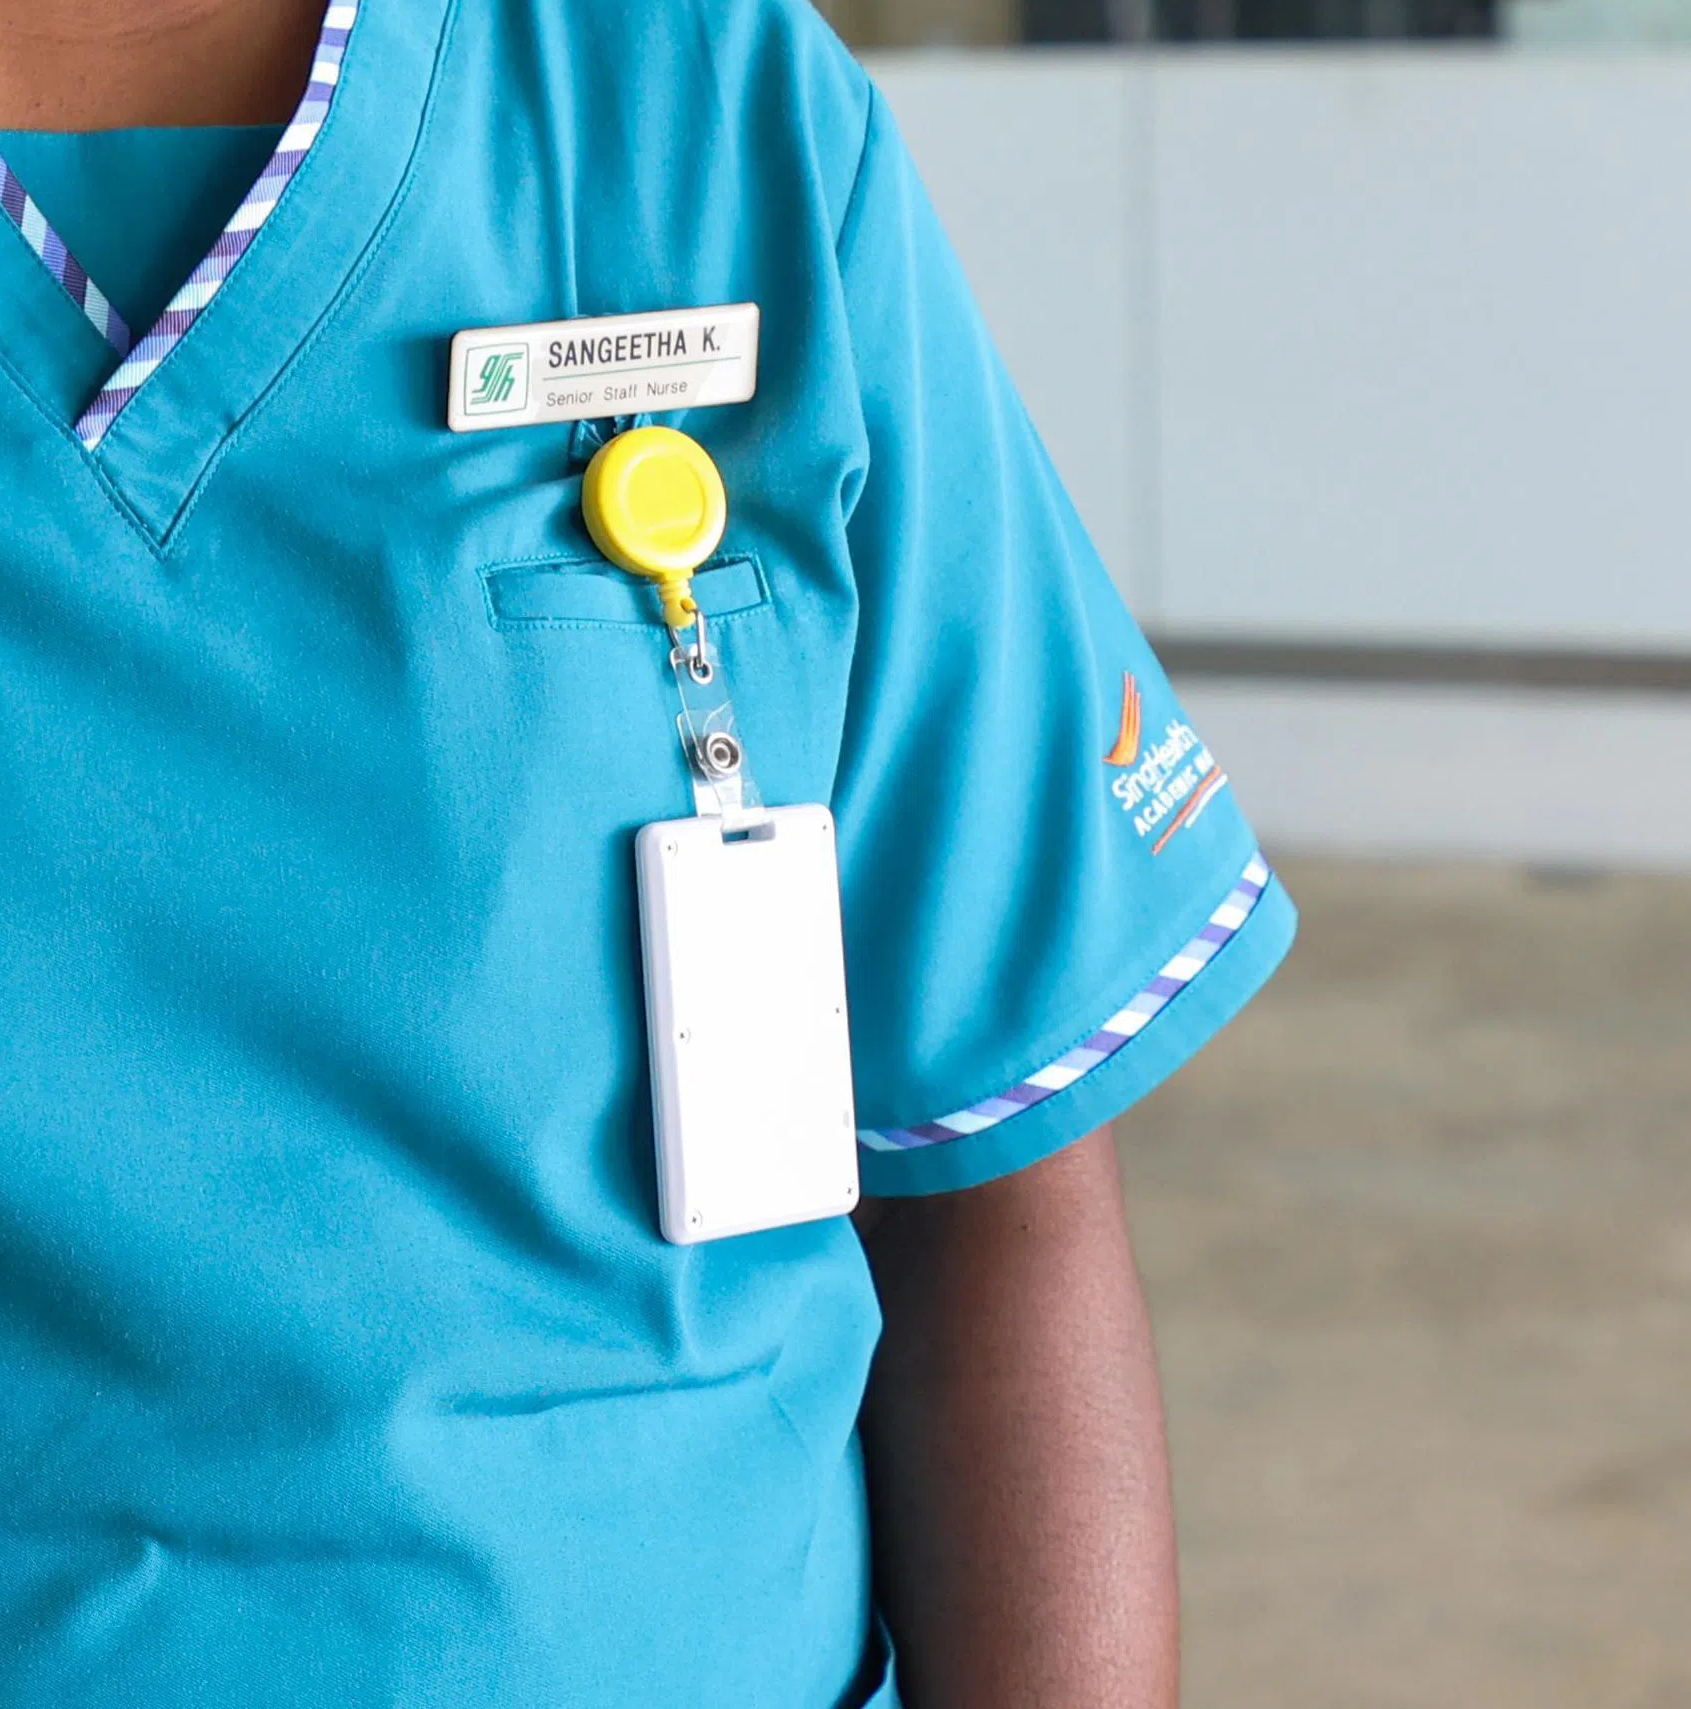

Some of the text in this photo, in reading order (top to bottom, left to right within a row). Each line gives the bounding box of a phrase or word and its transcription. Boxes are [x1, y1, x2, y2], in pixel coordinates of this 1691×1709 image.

[548, 325, 721, 369] SANGEETHA K.
[546, 378, 689, 408] Senior Staff Nurse
